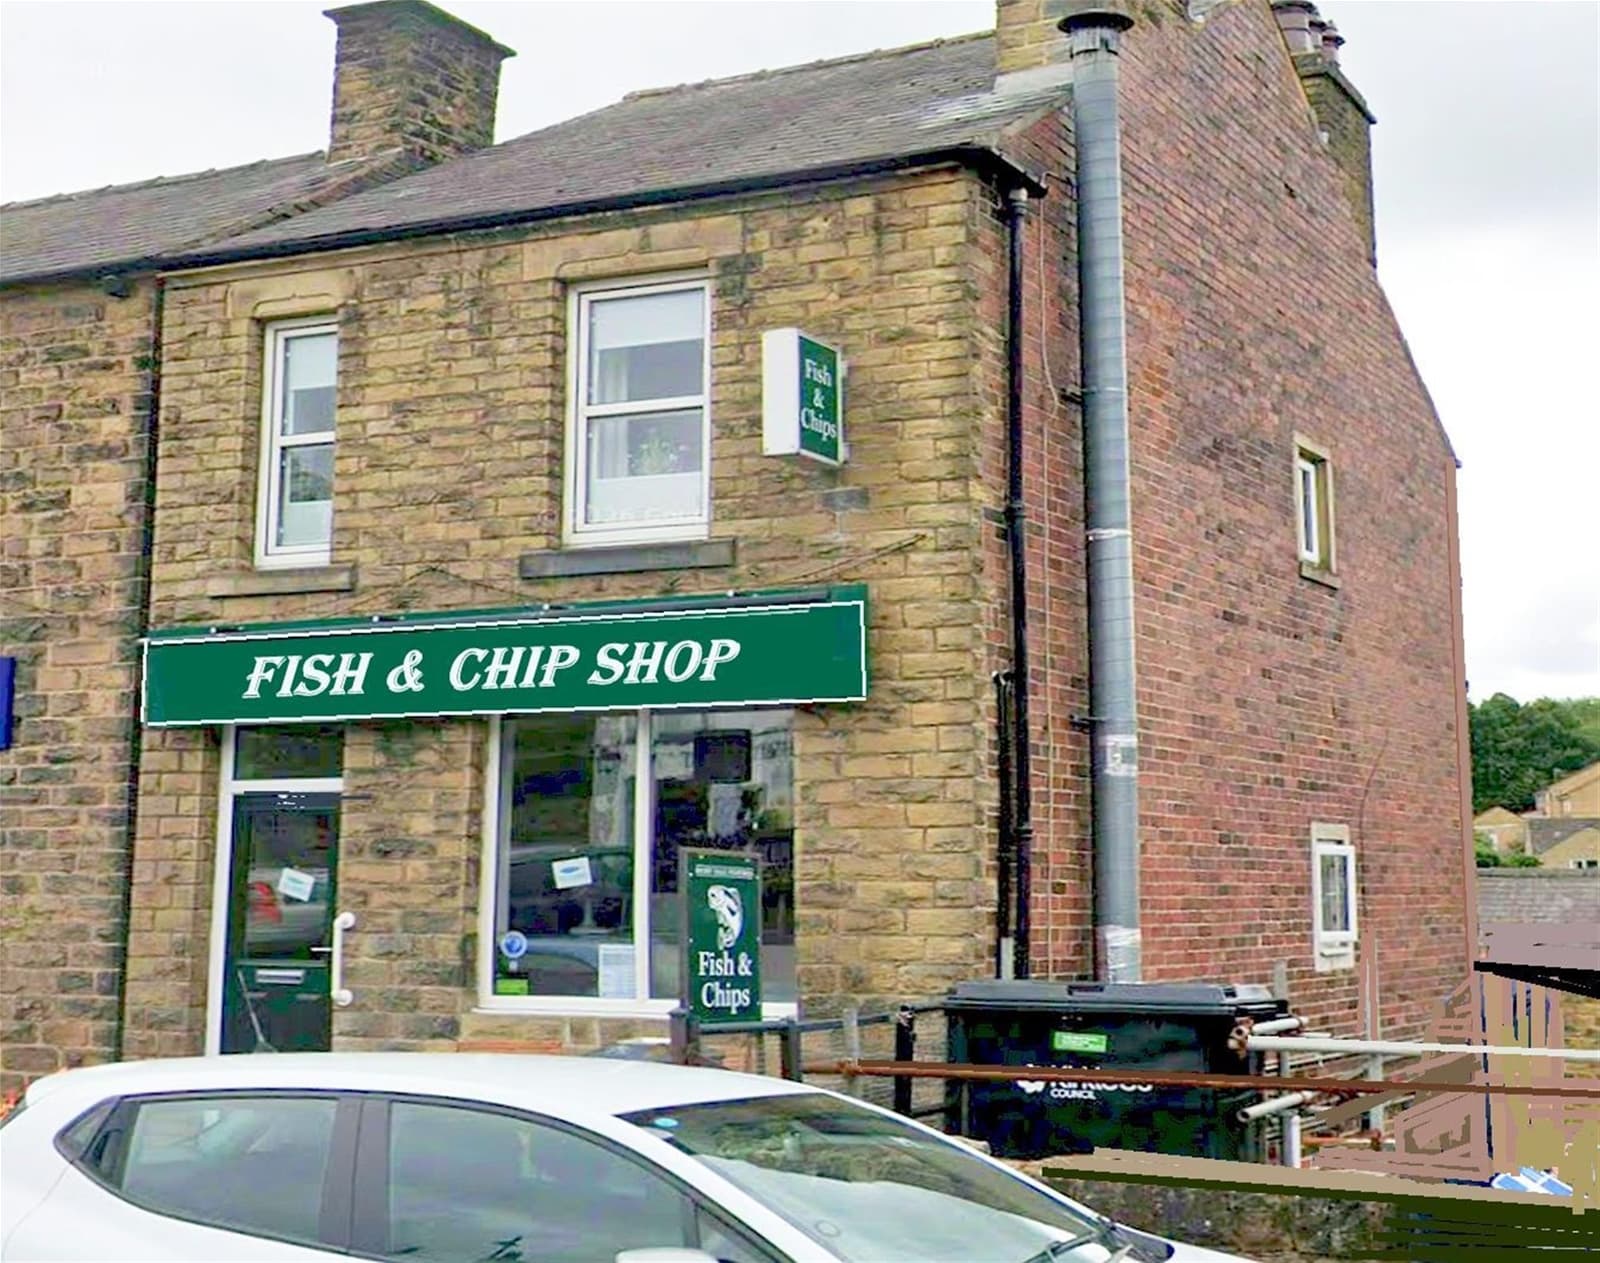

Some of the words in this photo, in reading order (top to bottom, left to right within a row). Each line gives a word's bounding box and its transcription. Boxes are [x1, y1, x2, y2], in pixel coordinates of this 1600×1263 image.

[805, 358, 832, 387] Fish
[813, 388, 825, 409] &
[801, 408, 837, 441] Chips
[242, 652, 374, 699] FISH
[386, 649, 425, 693] &
[449, 647, 581, 692] CHIP
[587, 639, 741, 686] SHOP
[698, 950, 734, 976] Fish
[738, 952, 752, 976] &
[702, 982, 751, 1014] Chips
[1050, 1088, 1096, 1100] COUNCIL
